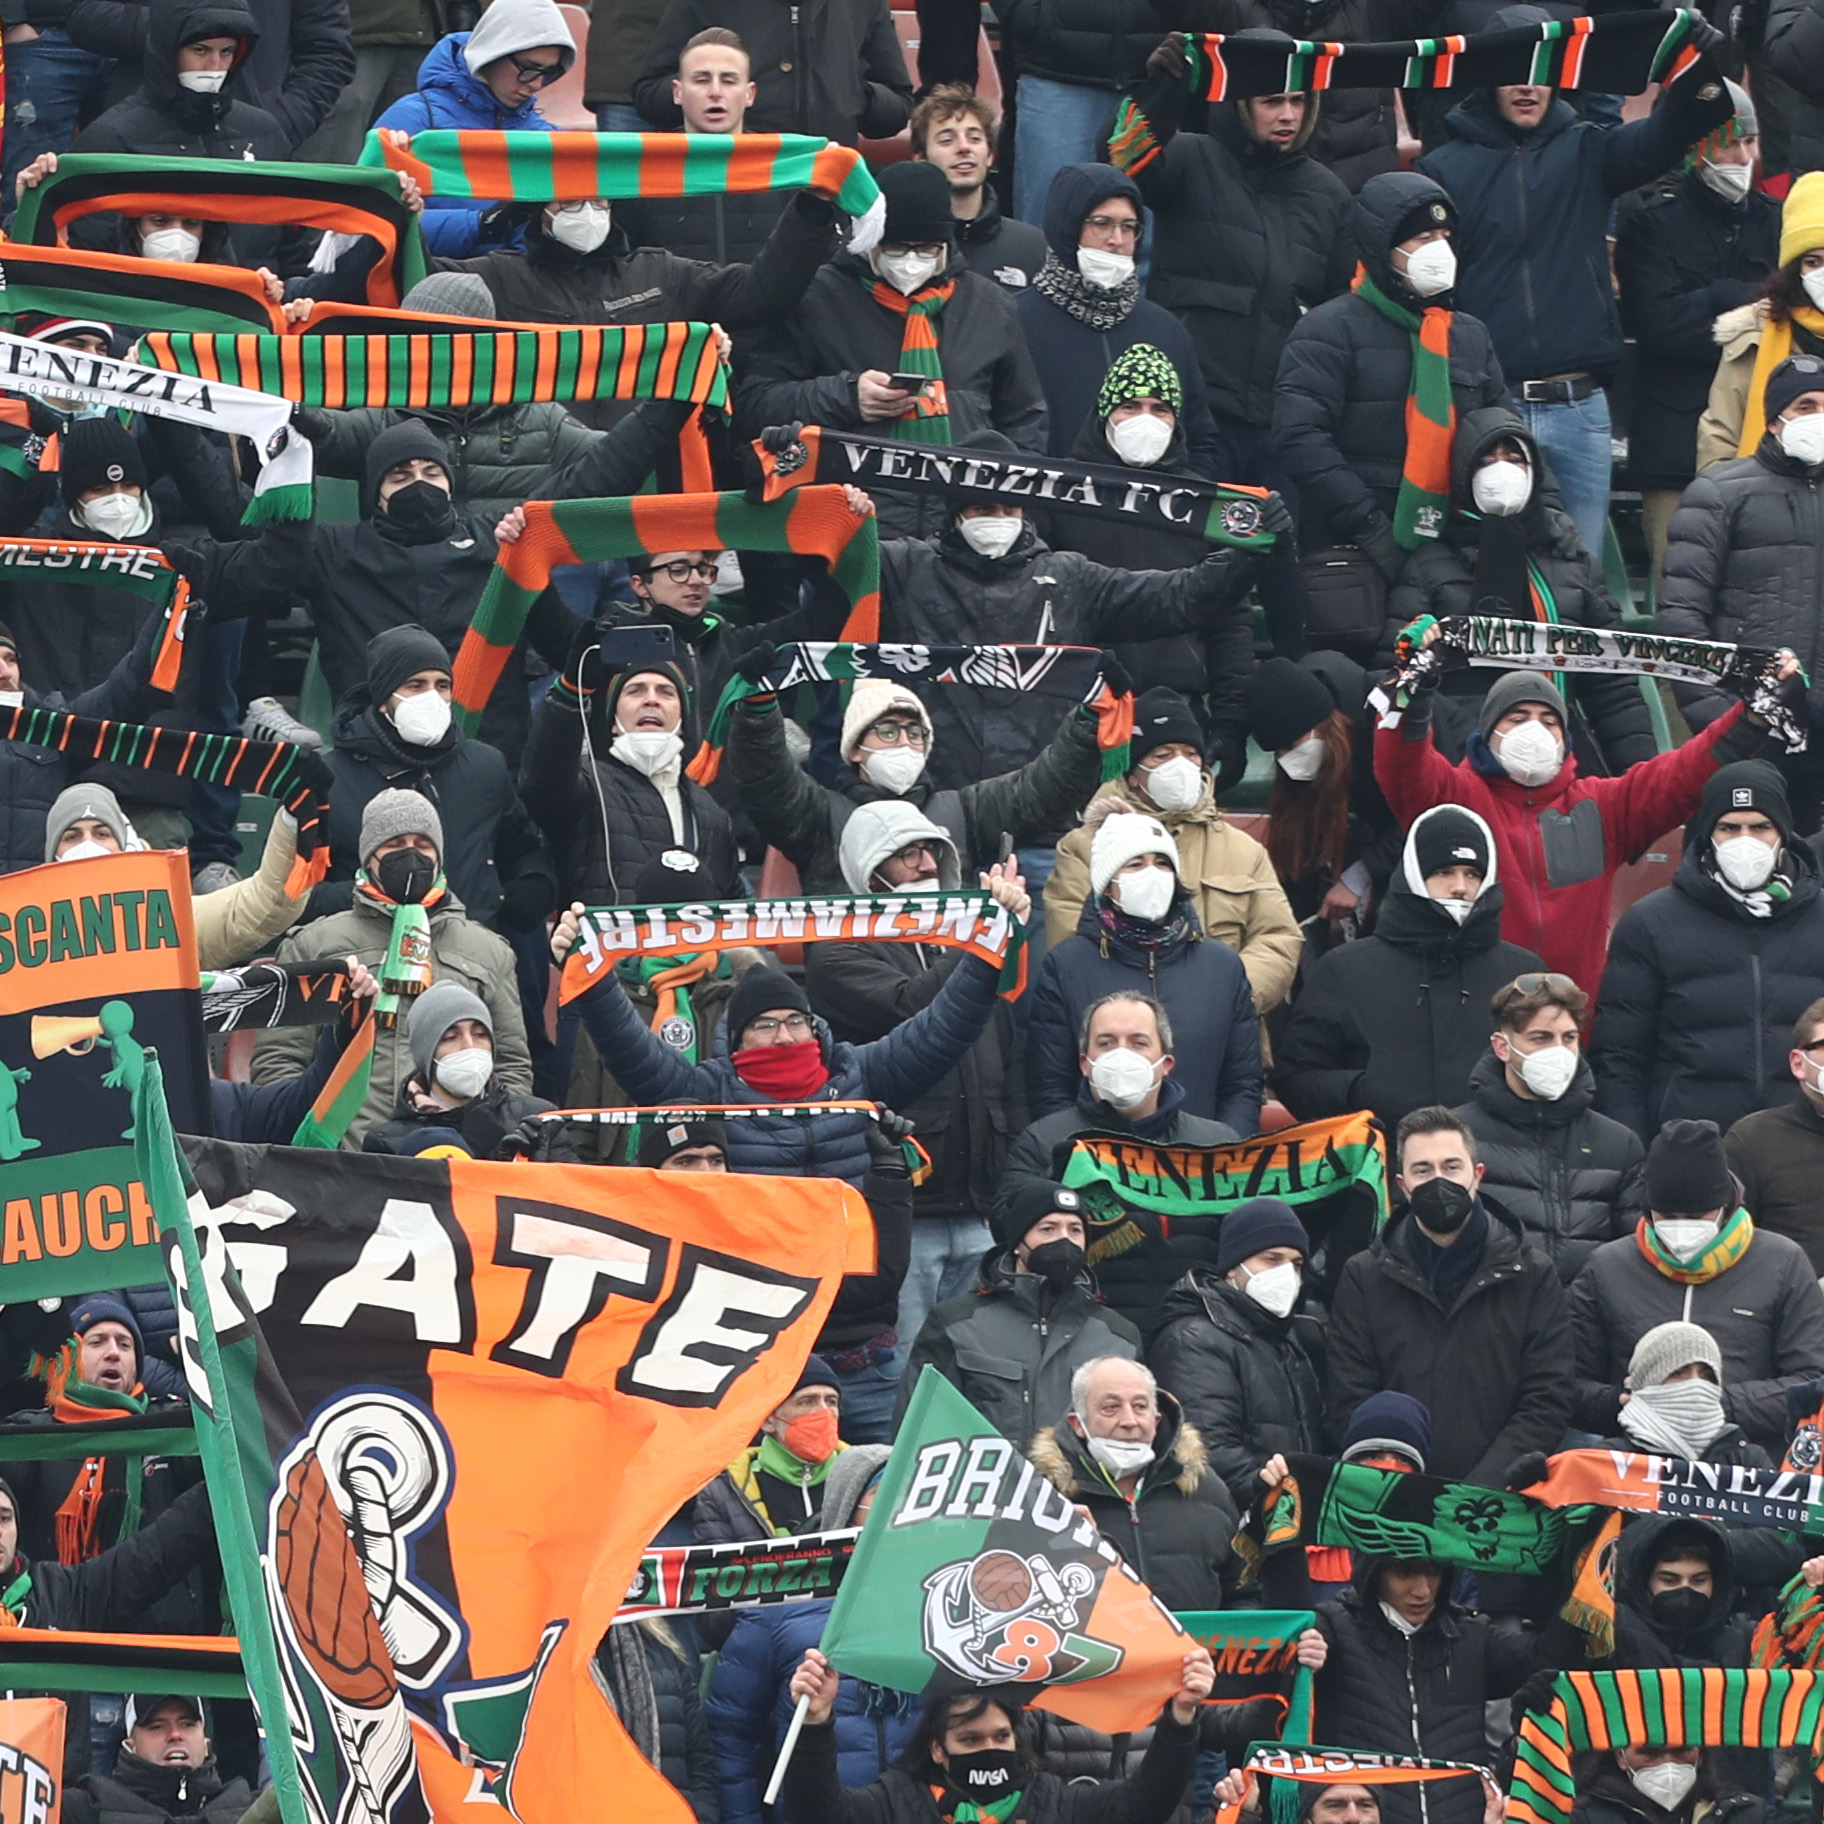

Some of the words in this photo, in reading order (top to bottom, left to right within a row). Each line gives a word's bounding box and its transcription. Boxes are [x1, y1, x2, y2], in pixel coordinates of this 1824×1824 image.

[17, 382, 108, 406] FOOTBALL
[115, 396, 164, 417] CLUB
[838, 442, 1104, 506] VENEZIA
[1119, 483, 1200, 525] FC
[1469, 616, 1535, 654] NATI
[1545, 626, 1604, 656] PER
[1656, 1491, 1750, 1514] FOOTBALL
[1763, 1503, 1810, 1522] CLUB
[690, 1556, 834, 1602] FORZA
[993, 1618, 1124, 1682] 87
[968, 1768, 1008, 1786] NASA
